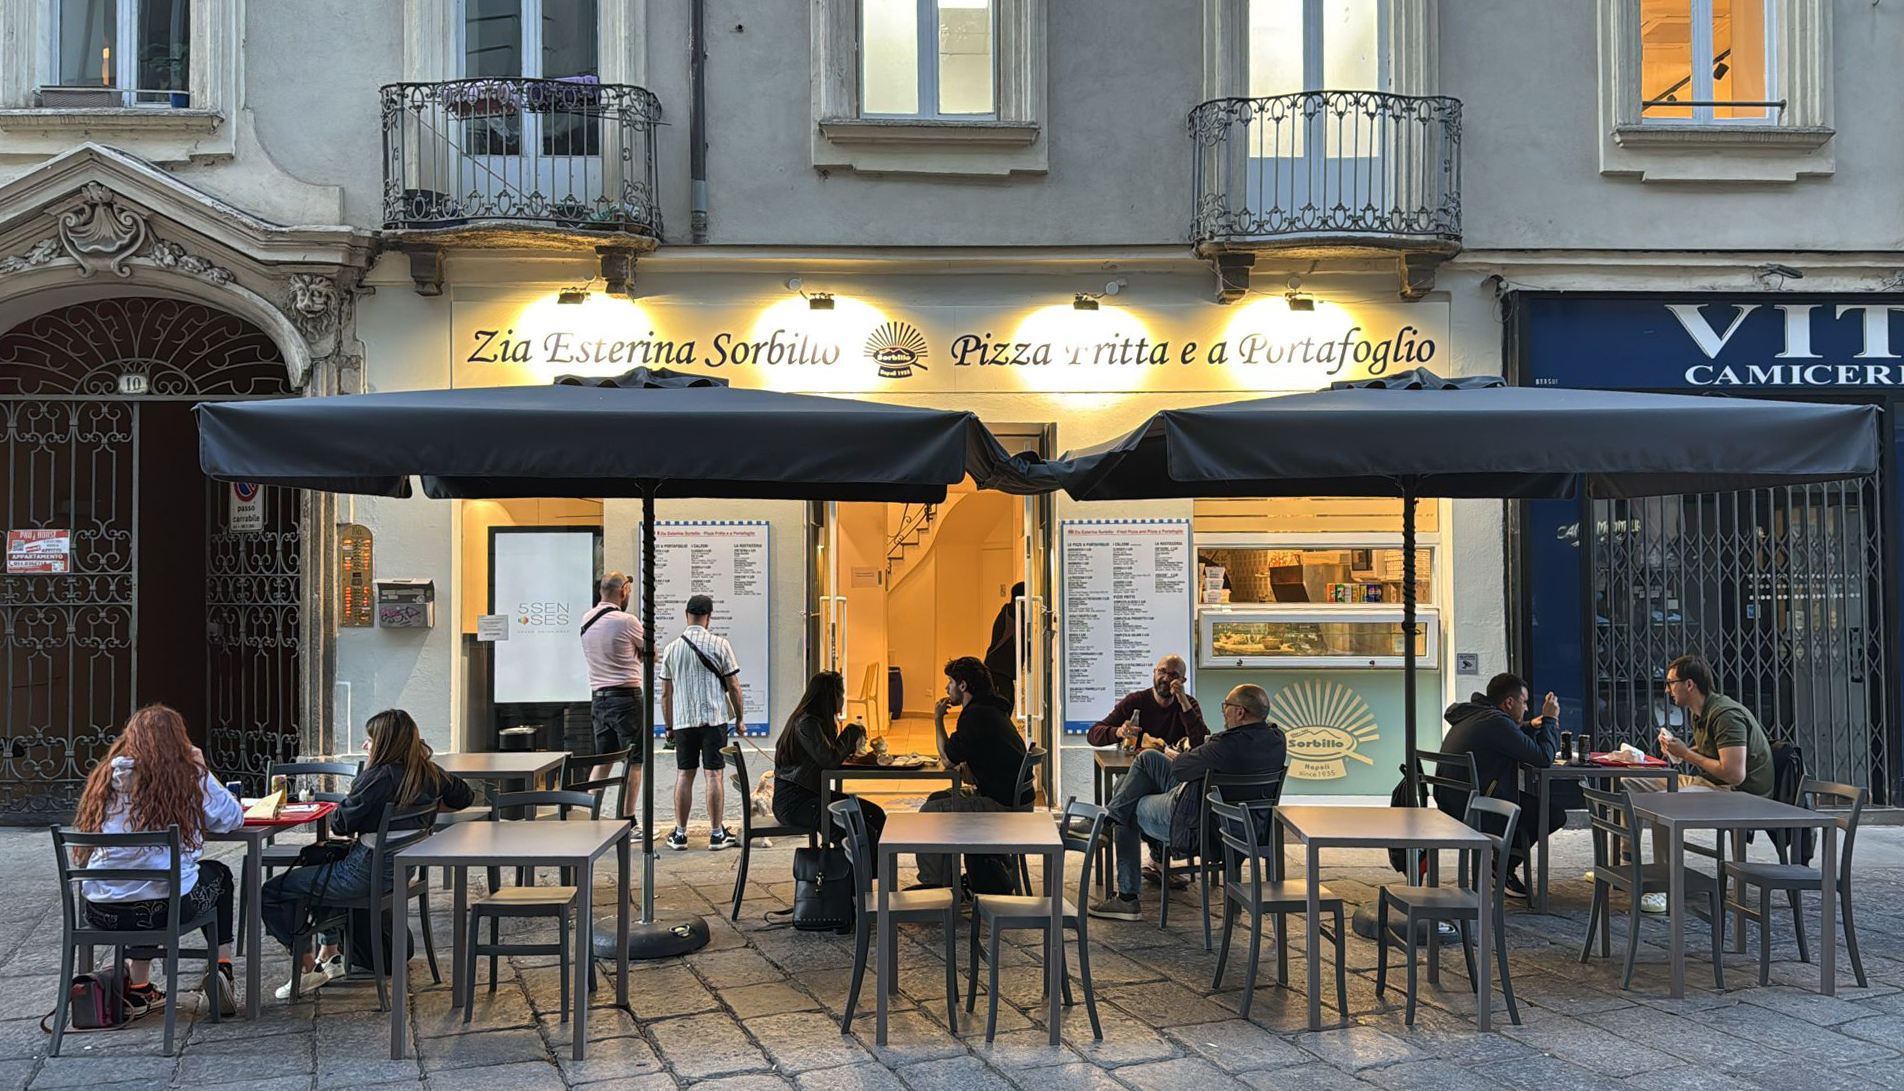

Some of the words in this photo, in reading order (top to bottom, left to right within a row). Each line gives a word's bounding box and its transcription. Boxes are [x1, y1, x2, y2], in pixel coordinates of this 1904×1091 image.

[467, 330, 532, 364] Zia
[543, 331, 697, 365] Esterina
[704, 329, 841, 368] Sorbillo
[951, 333, 1051, 367] Pizza
[1180, 340, 1198, 364] e
[1207, 340, 1228, 365] a
[1239, 326, 1437, 376] Portafoglio
[126, 377, 141, 391] 10
[237, 505, 256, 513] passo
[1288, 739, 1344, 748] Sorbillo
[1304, 763, 1330, 771] Napoli
